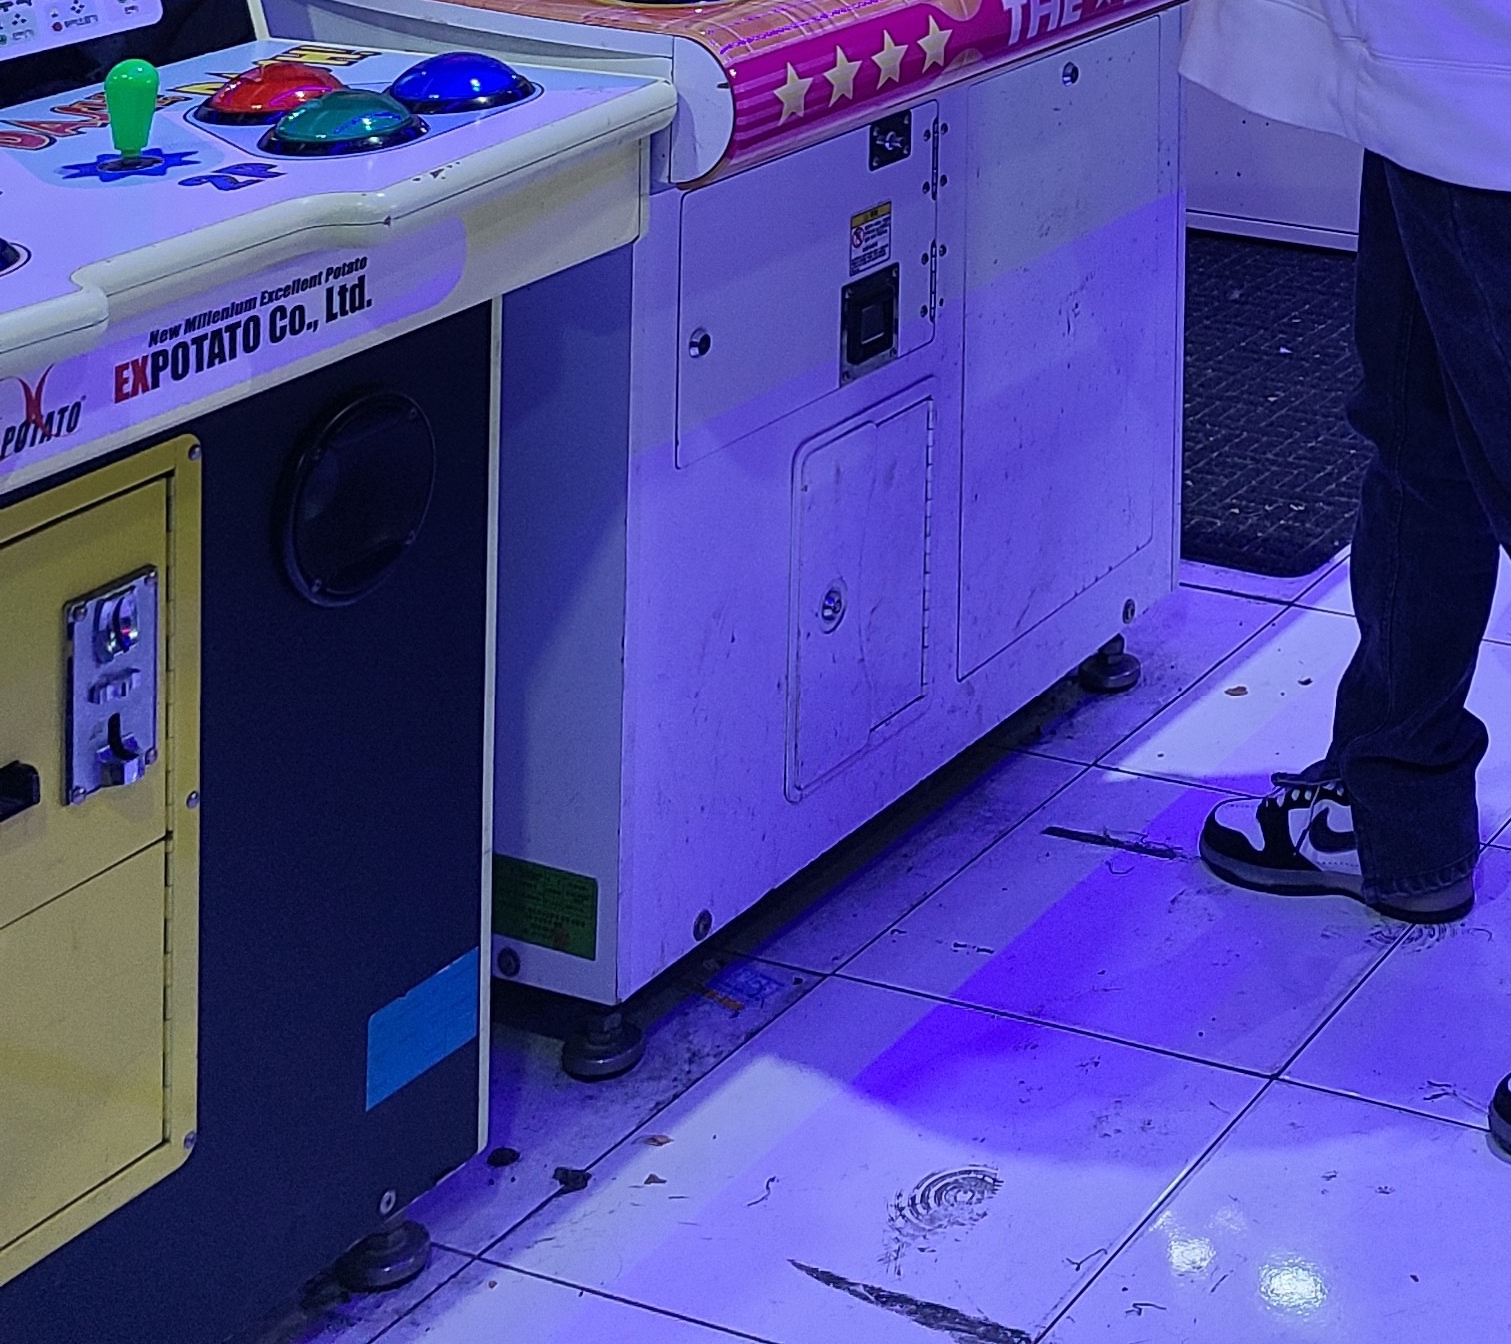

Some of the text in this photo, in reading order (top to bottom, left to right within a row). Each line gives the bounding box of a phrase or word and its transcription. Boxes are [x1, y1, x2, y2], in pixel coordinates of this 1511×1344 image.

[114, 313, 261, 405] EXPOTATO
[325, 274, 374, 323] Ltd.
[148, 328, 182, 348] New
[260, 271, 323, 306] Excellent
[325, 255, 368, 284] Potato
